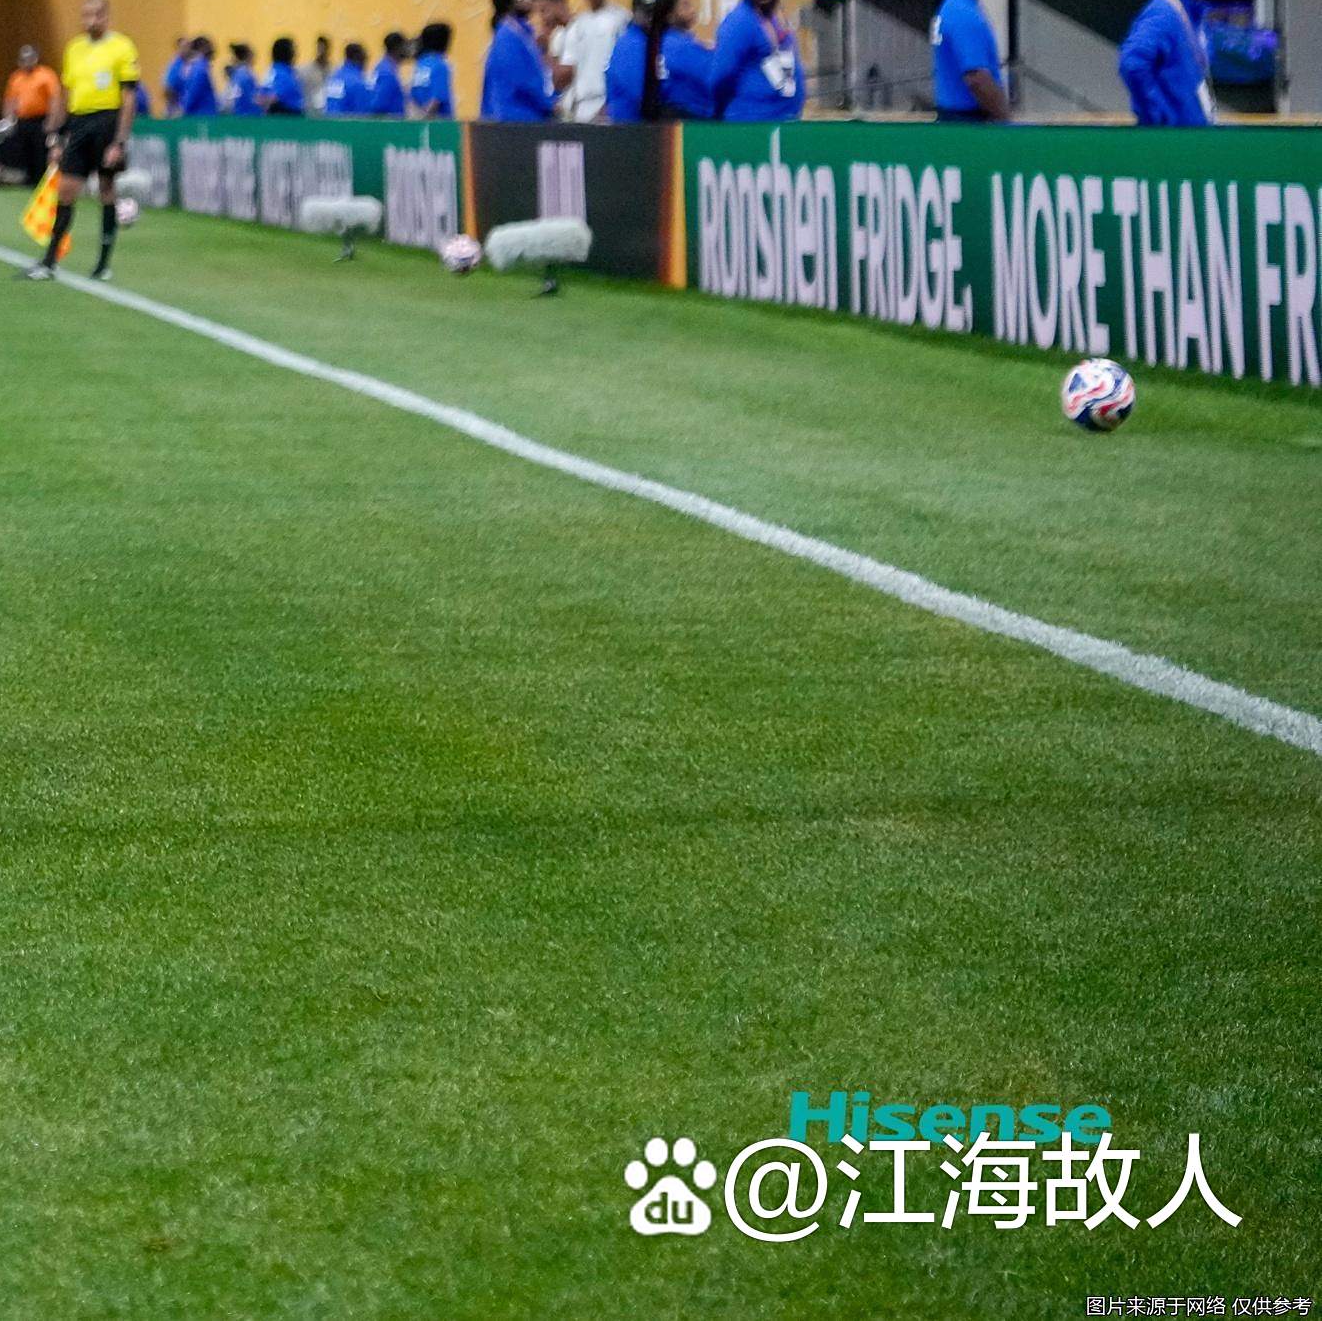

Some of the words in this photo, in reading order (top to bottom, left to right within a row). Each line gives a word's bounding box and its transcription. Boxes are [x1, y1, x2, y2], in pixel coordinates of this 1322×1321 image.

[697, 127, 838, 312] Ronshen
[850, 162, 974, 332] FRIDGE.
[991, 174, 1110, 355] MORE
[1112, 177, 1245, 378] THAN
[1254, 183, 1322, 387] FR
